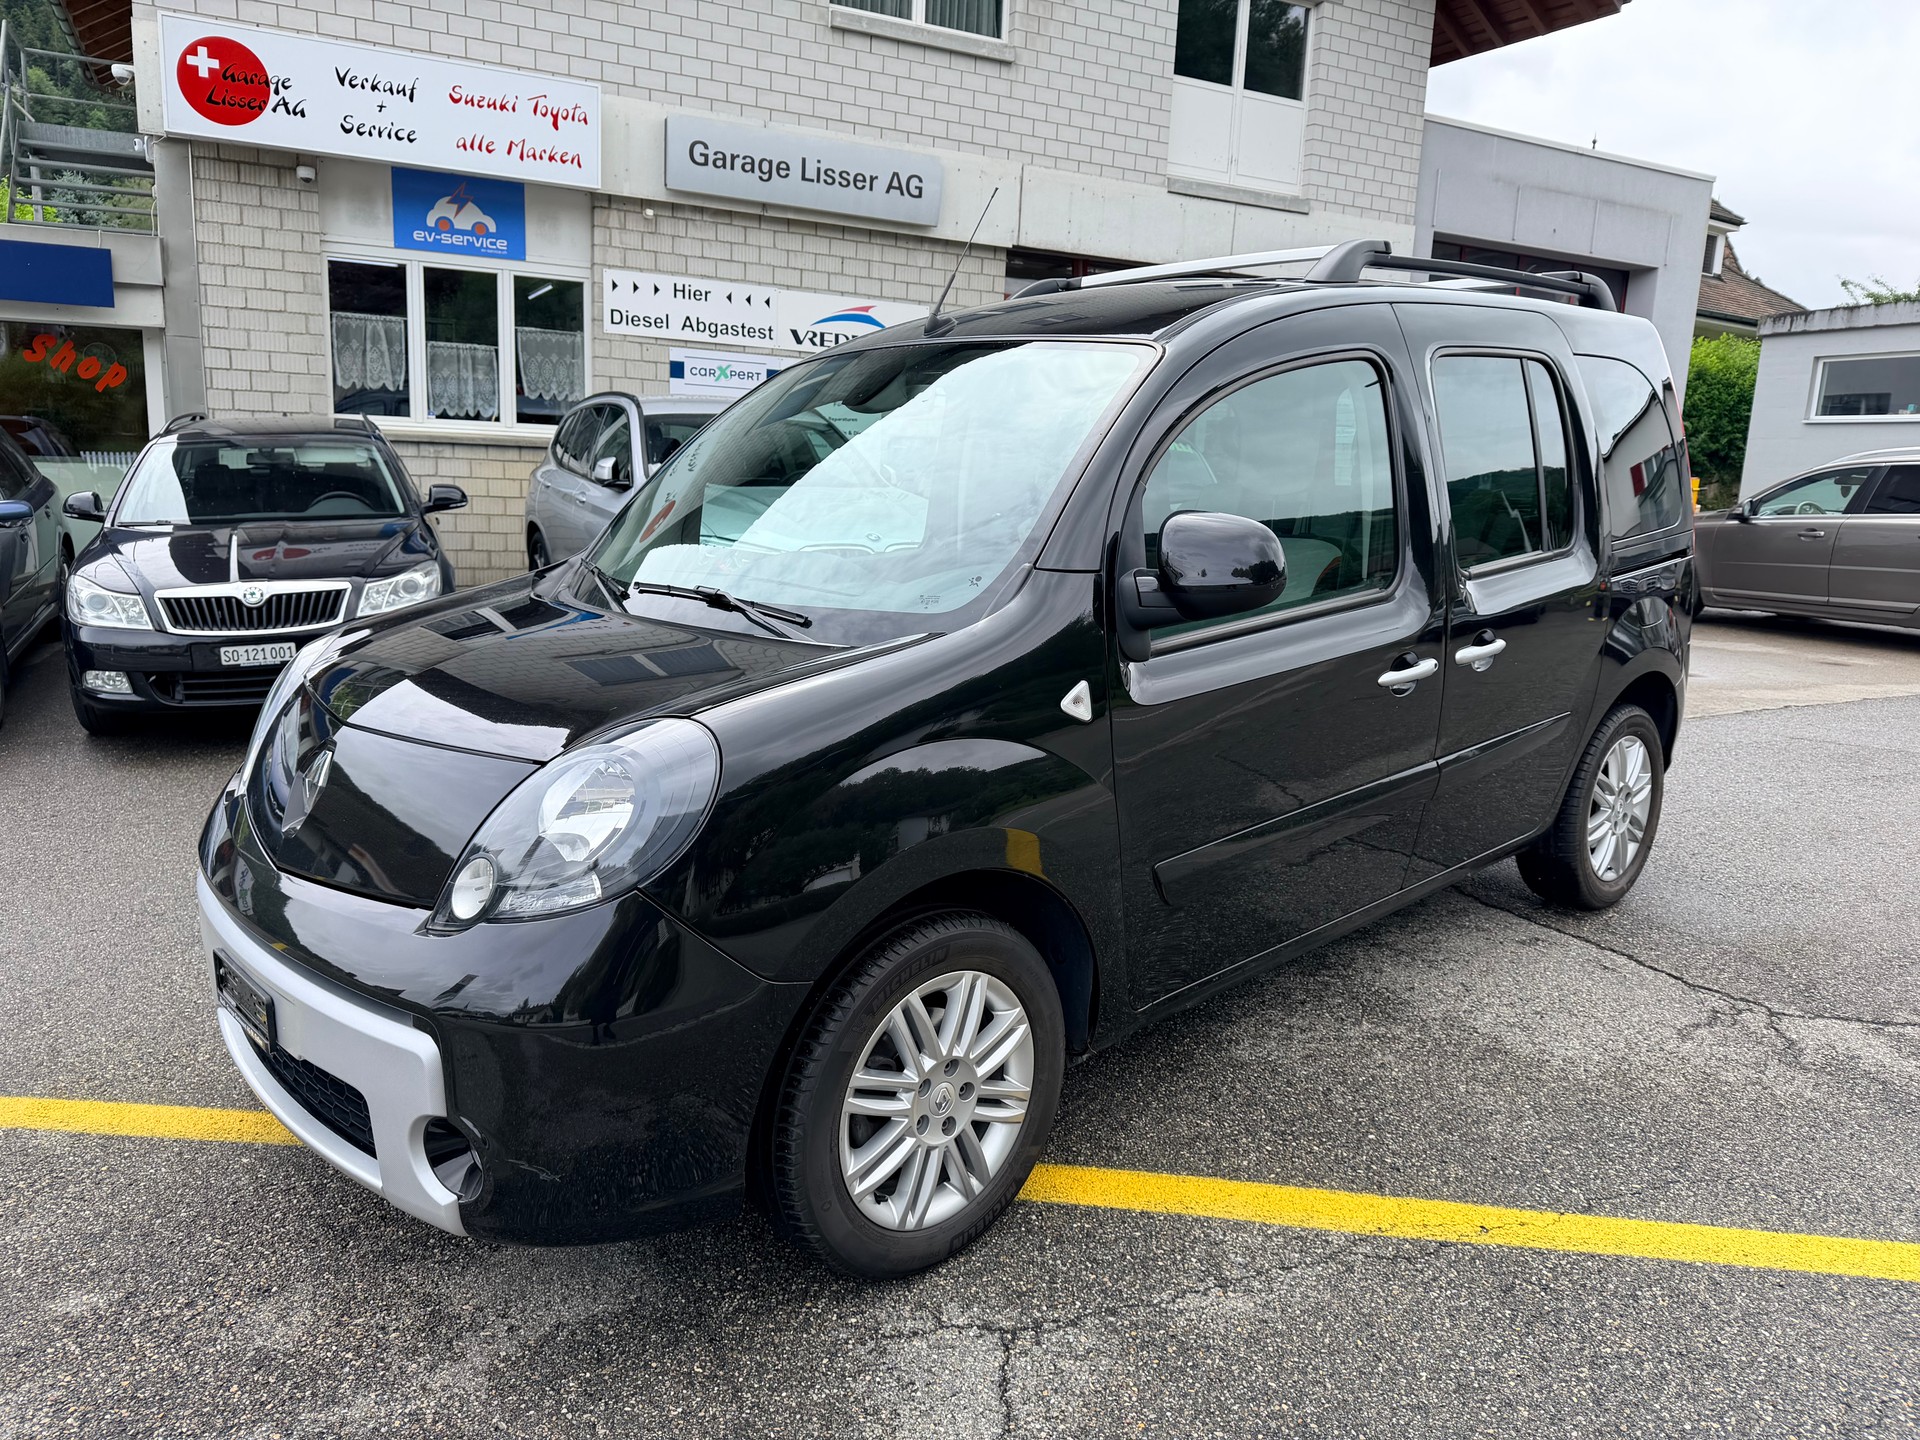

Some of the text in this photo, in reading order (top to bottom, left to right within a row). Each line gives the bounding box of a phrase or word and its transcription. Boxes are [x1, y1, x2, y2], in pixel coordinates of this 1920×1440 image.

[221, 63, 292, 96] Garage
[335, 66, 419, 103] Verkauf
[205, 84, 307, 118] Lisser AG
[449, 85, 588, 131] Suzuki Toyota
[340, 114, 417, 143] Service
[456, 134, 582, 169] alle Marken
[688, 140, 924, 199] Garage Lisser AG
[413, 230, 508, 250] ev-service
[673, 283, 711, 302] Hier
[610, 309, 774, 340] Diesel Abgastest
[790, 328, 859, 348] VRED
[23, 334, 127, 392] Shop
